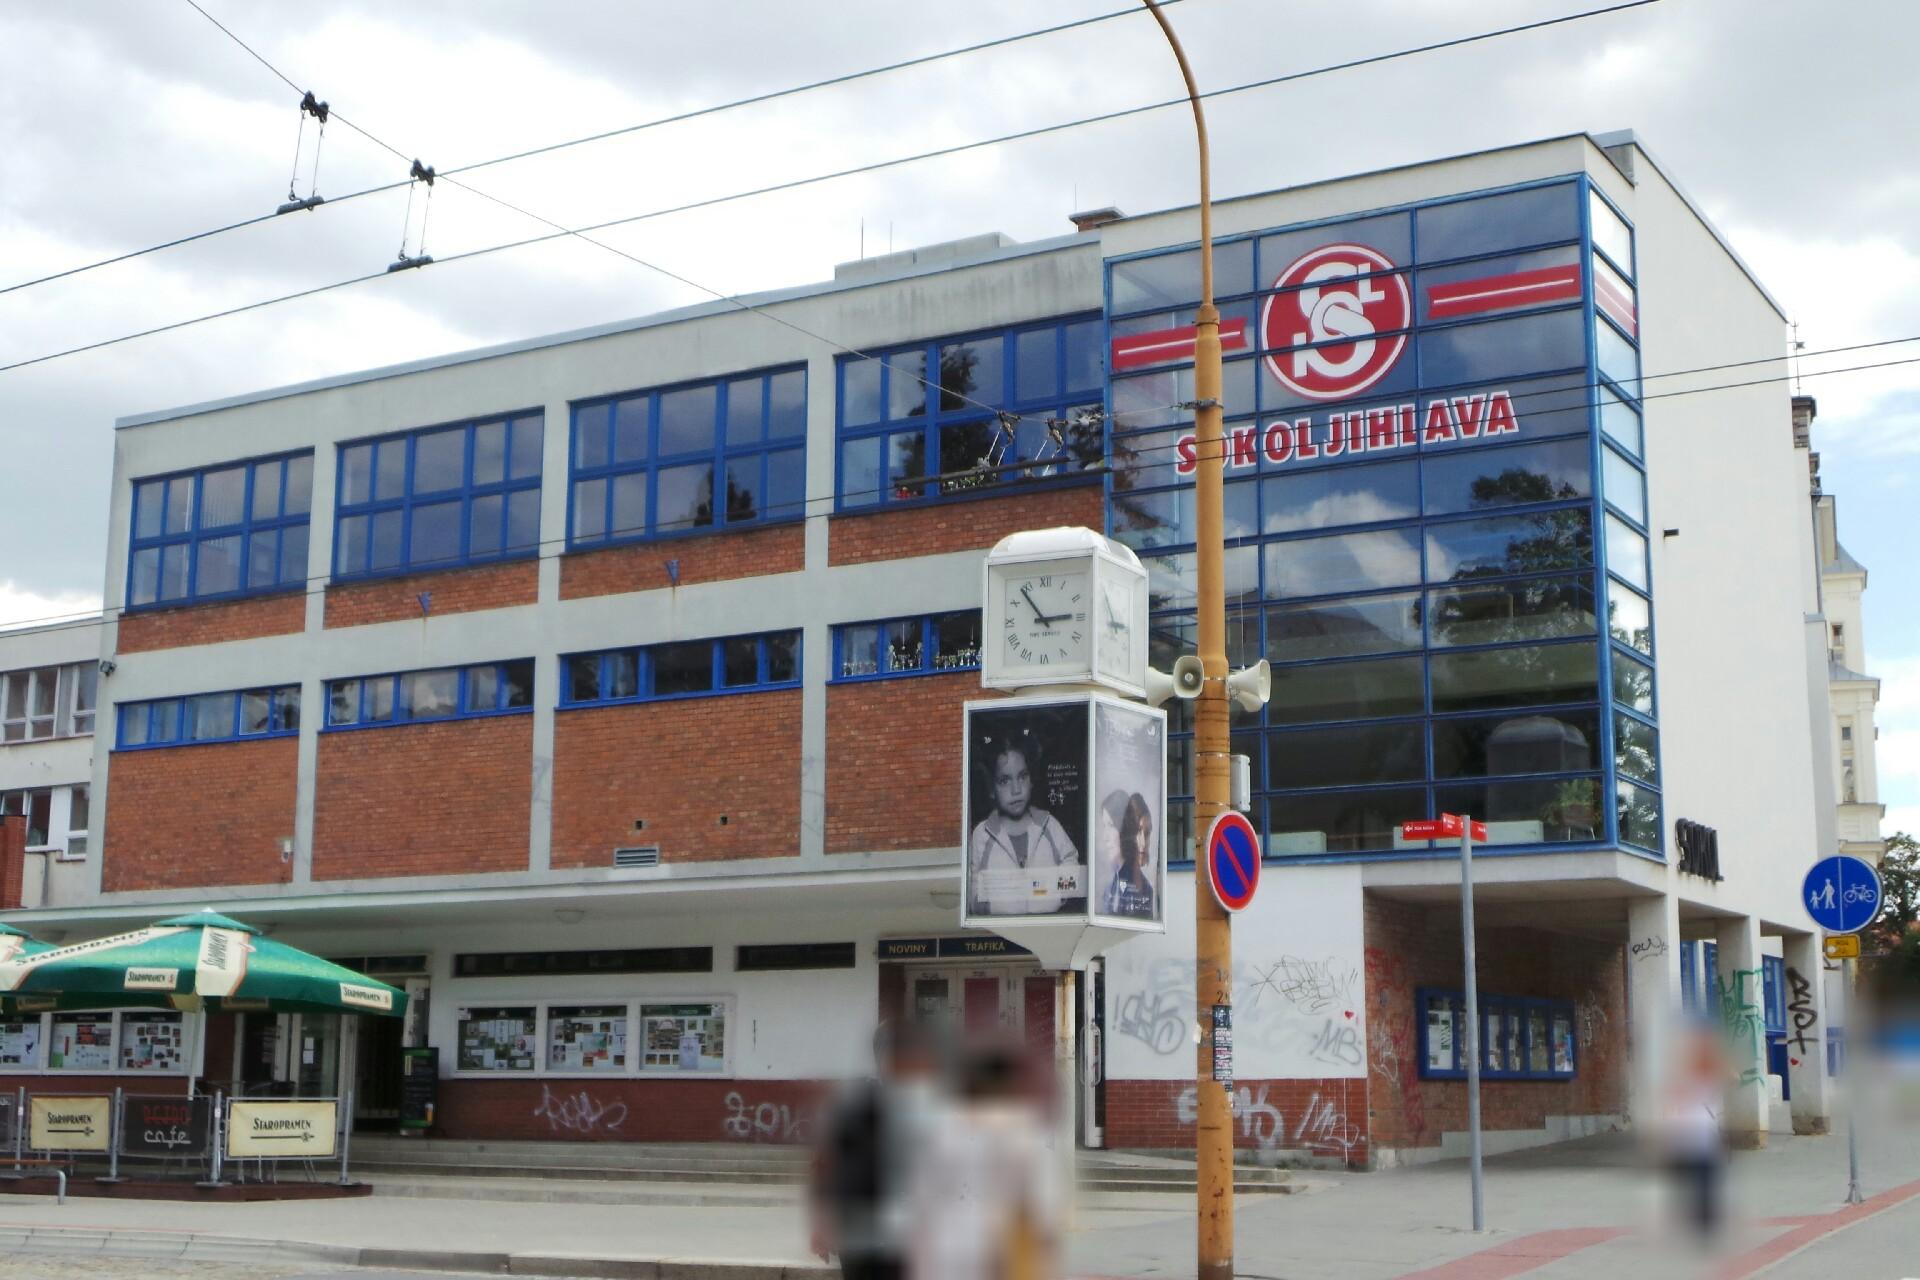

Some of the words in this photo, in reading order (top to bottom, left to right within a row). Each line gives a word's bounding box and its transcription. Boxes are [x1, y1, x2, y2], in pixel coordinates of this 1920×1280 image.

[1176, 416, 1319, 475] SKOL
[1323, 390, 1520, 457] JIHLAVA
[889, 944, 927, 954] NOVINY
[966, 941, 1006, 952] TRAFIKA
[47, 1111, 92, 1125] STAROPRAMEN
[253, 1117, 312, 1131] STAROPRAMEN
